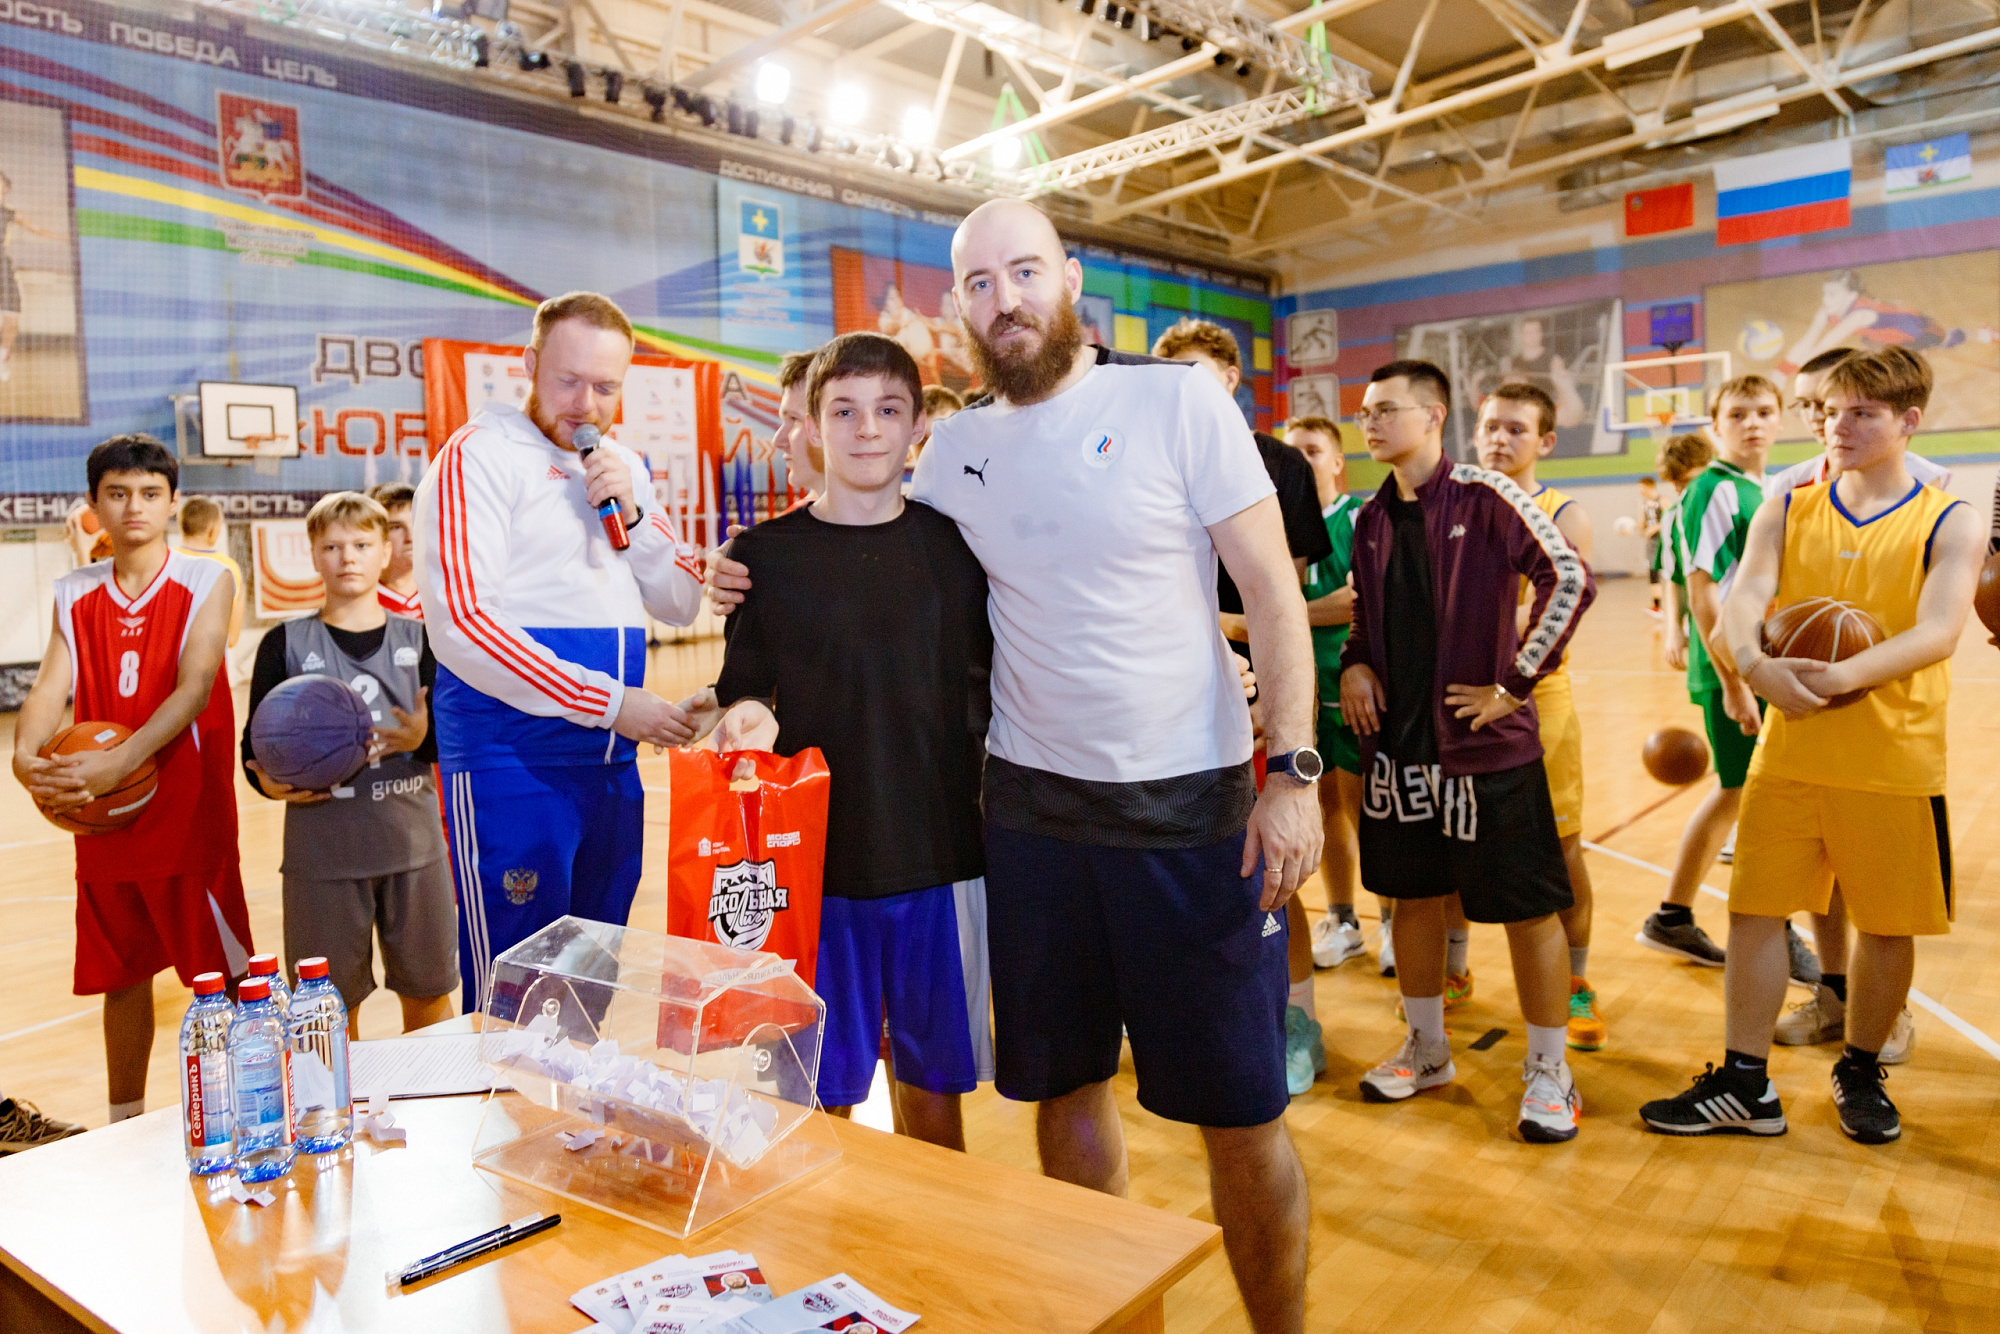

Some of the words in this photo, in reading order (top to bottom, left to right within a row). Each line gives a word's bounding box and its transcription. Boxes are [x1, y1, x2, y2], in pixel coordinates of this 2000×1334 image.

[109, 21, 241, 68] ПОБЕДА
[261, 54, 338, 88] ЦЕЛЬ
[719, 159, 835, 200] ДОСТИЖЕНИЯ
[118, 649, 140, 699] 8
[371, 775, 424, 802] group
[1261, 923, 1282, 938] adidas
[188, 1063, 203, 1139] СемерикЪ
